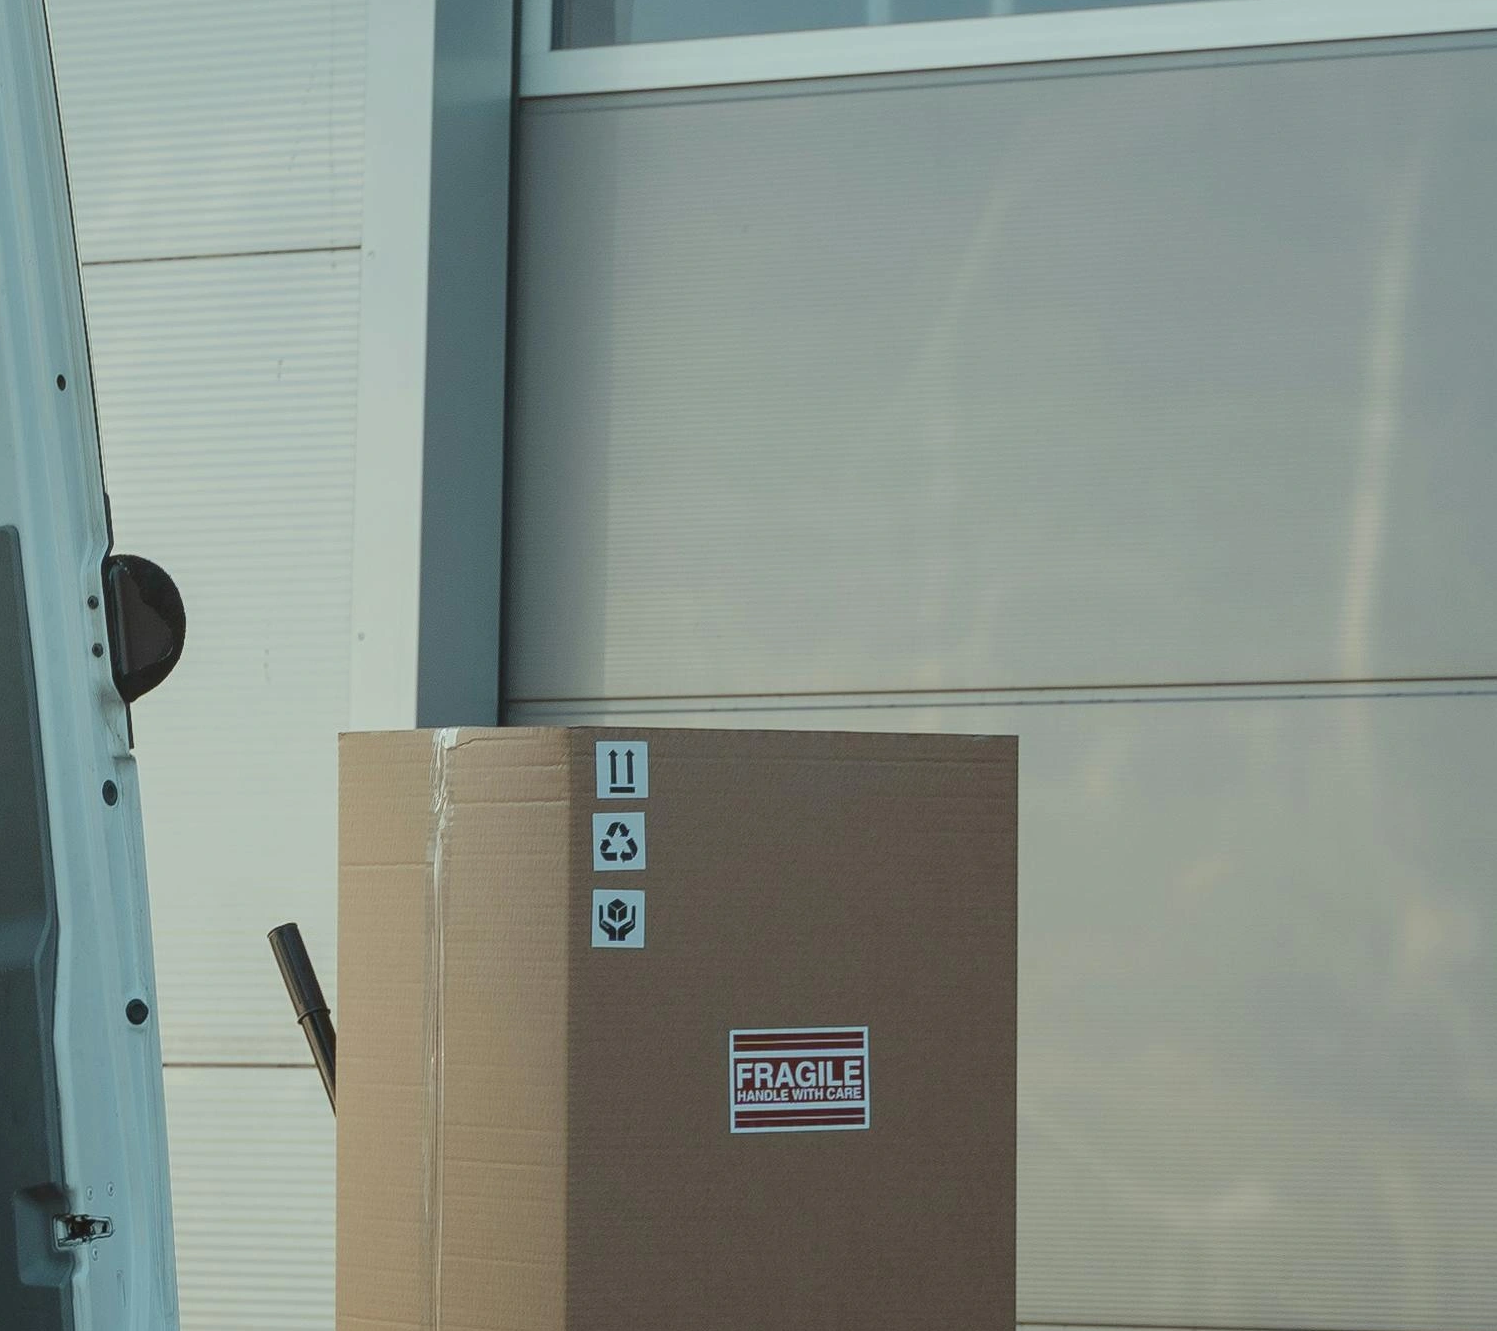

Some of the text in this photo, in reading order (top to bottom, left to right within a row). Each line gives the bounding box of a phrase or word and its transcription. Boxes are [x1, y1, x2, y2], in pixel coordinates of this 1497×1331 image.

[736, 1060, 862, 1089] FRAGILE
[737, 1087, 862, 1102] HANDLE WITH CARE
